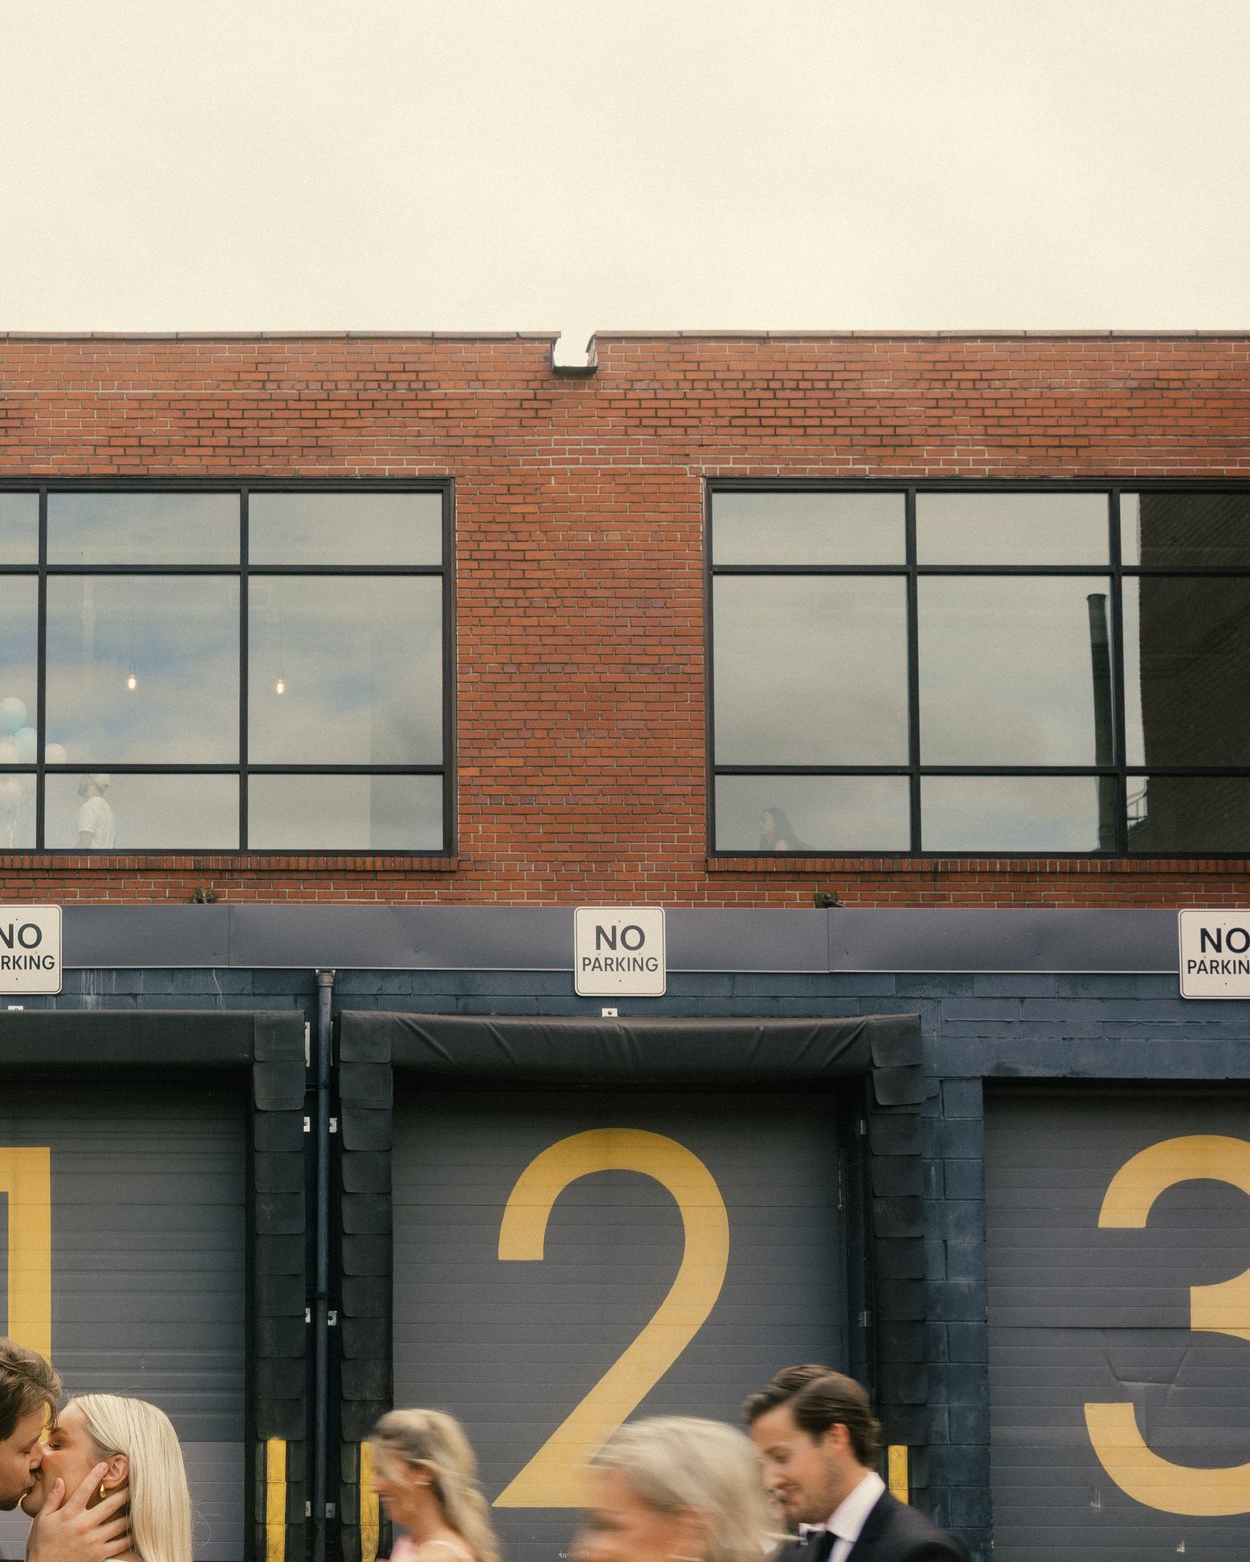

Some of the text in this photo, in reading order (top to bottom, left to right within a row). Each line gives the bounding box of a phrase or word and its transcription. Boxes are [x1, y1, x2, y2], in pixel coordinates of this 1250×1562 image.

[595, 925, 645, 951] NO
[1200, 927, 1250, 953] NO
[582, 957, 659, 972] PARKING
[1187, 959, 1250, 975] PARKIN
[491, 1127, 731, 1508] 2
[1084, 1135, 1250, 1516] 3
